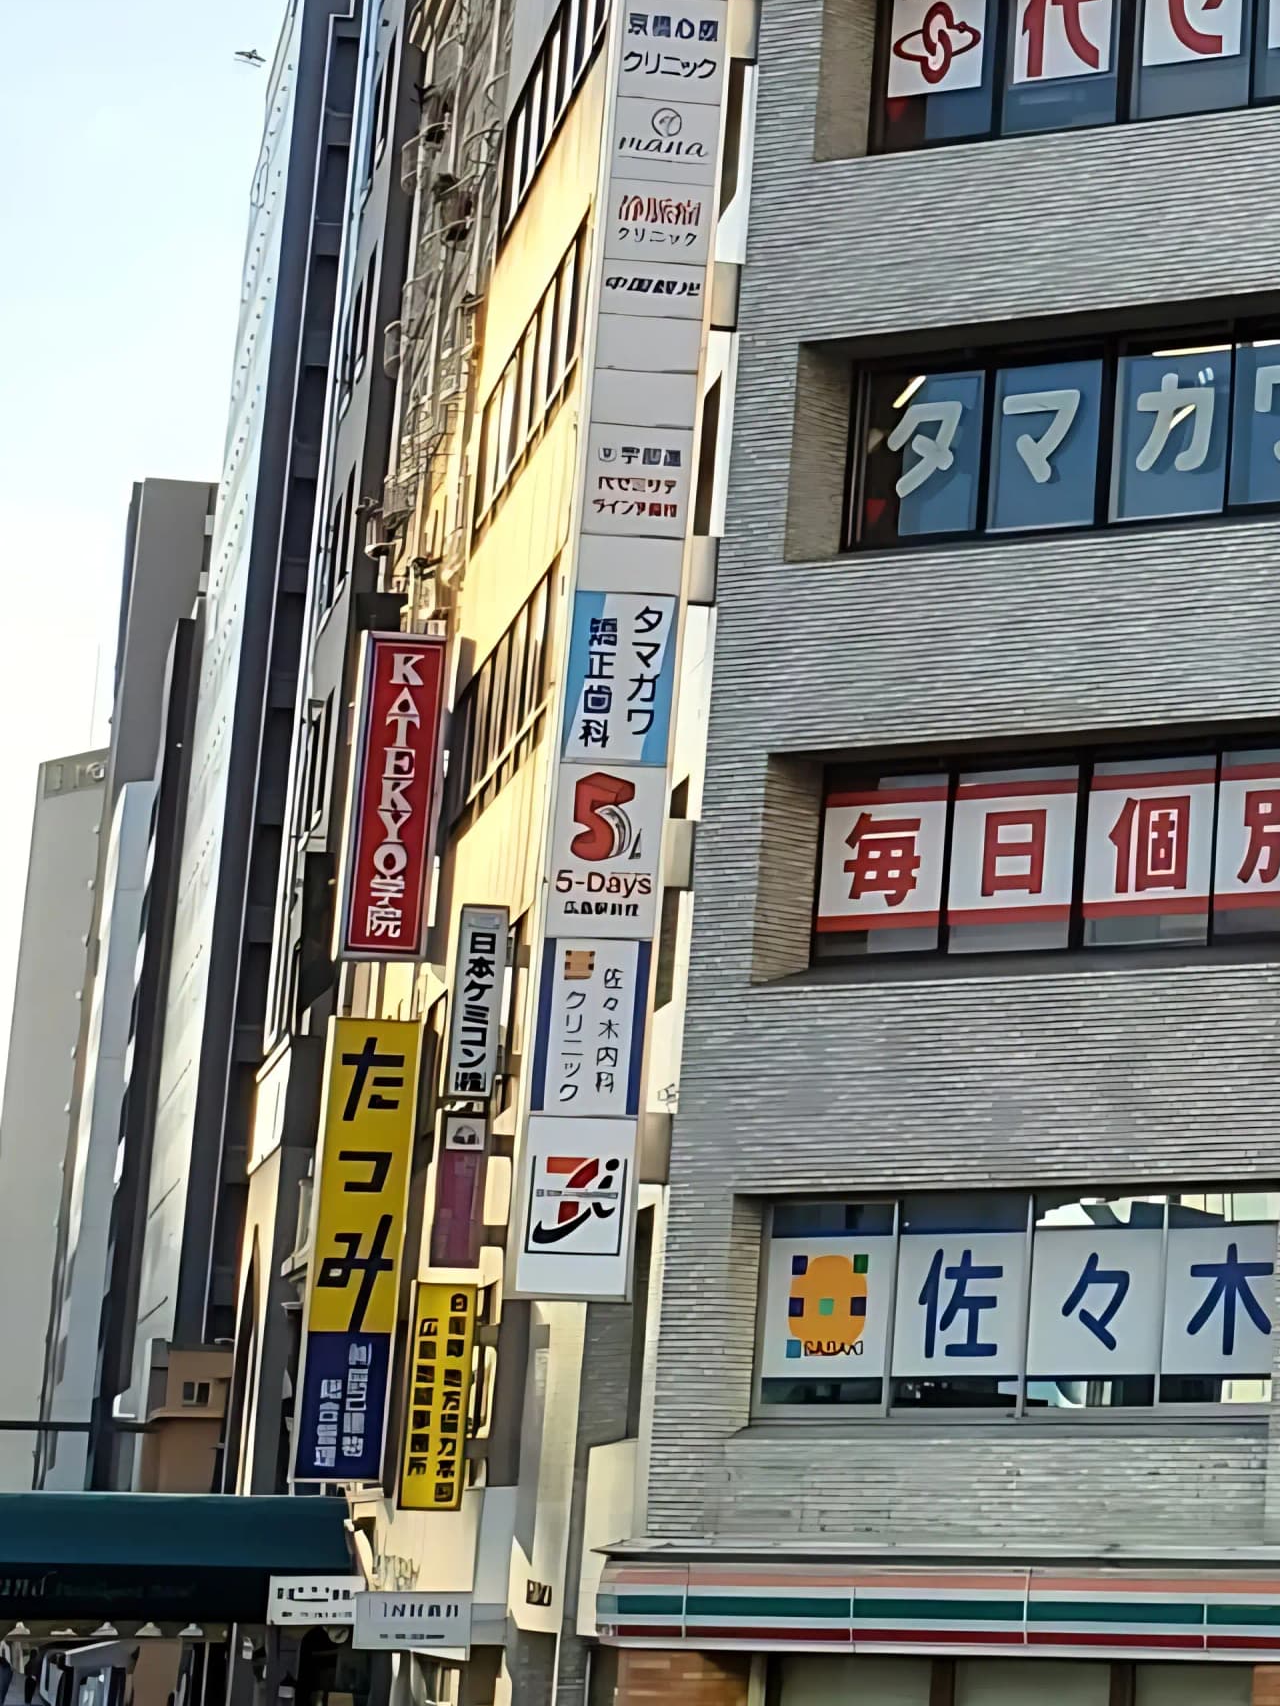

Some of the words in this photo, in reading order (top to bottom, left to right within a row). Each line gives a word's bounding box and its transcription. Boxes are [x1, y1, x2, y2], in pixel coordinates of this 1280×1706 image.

[624, 51, 717, 79] クリニック
[626, 606, 663, 735] タマガワ
[559, 991, 586, 1102] クリニック
[918, 1243, 1275, 1358] 佐々木
